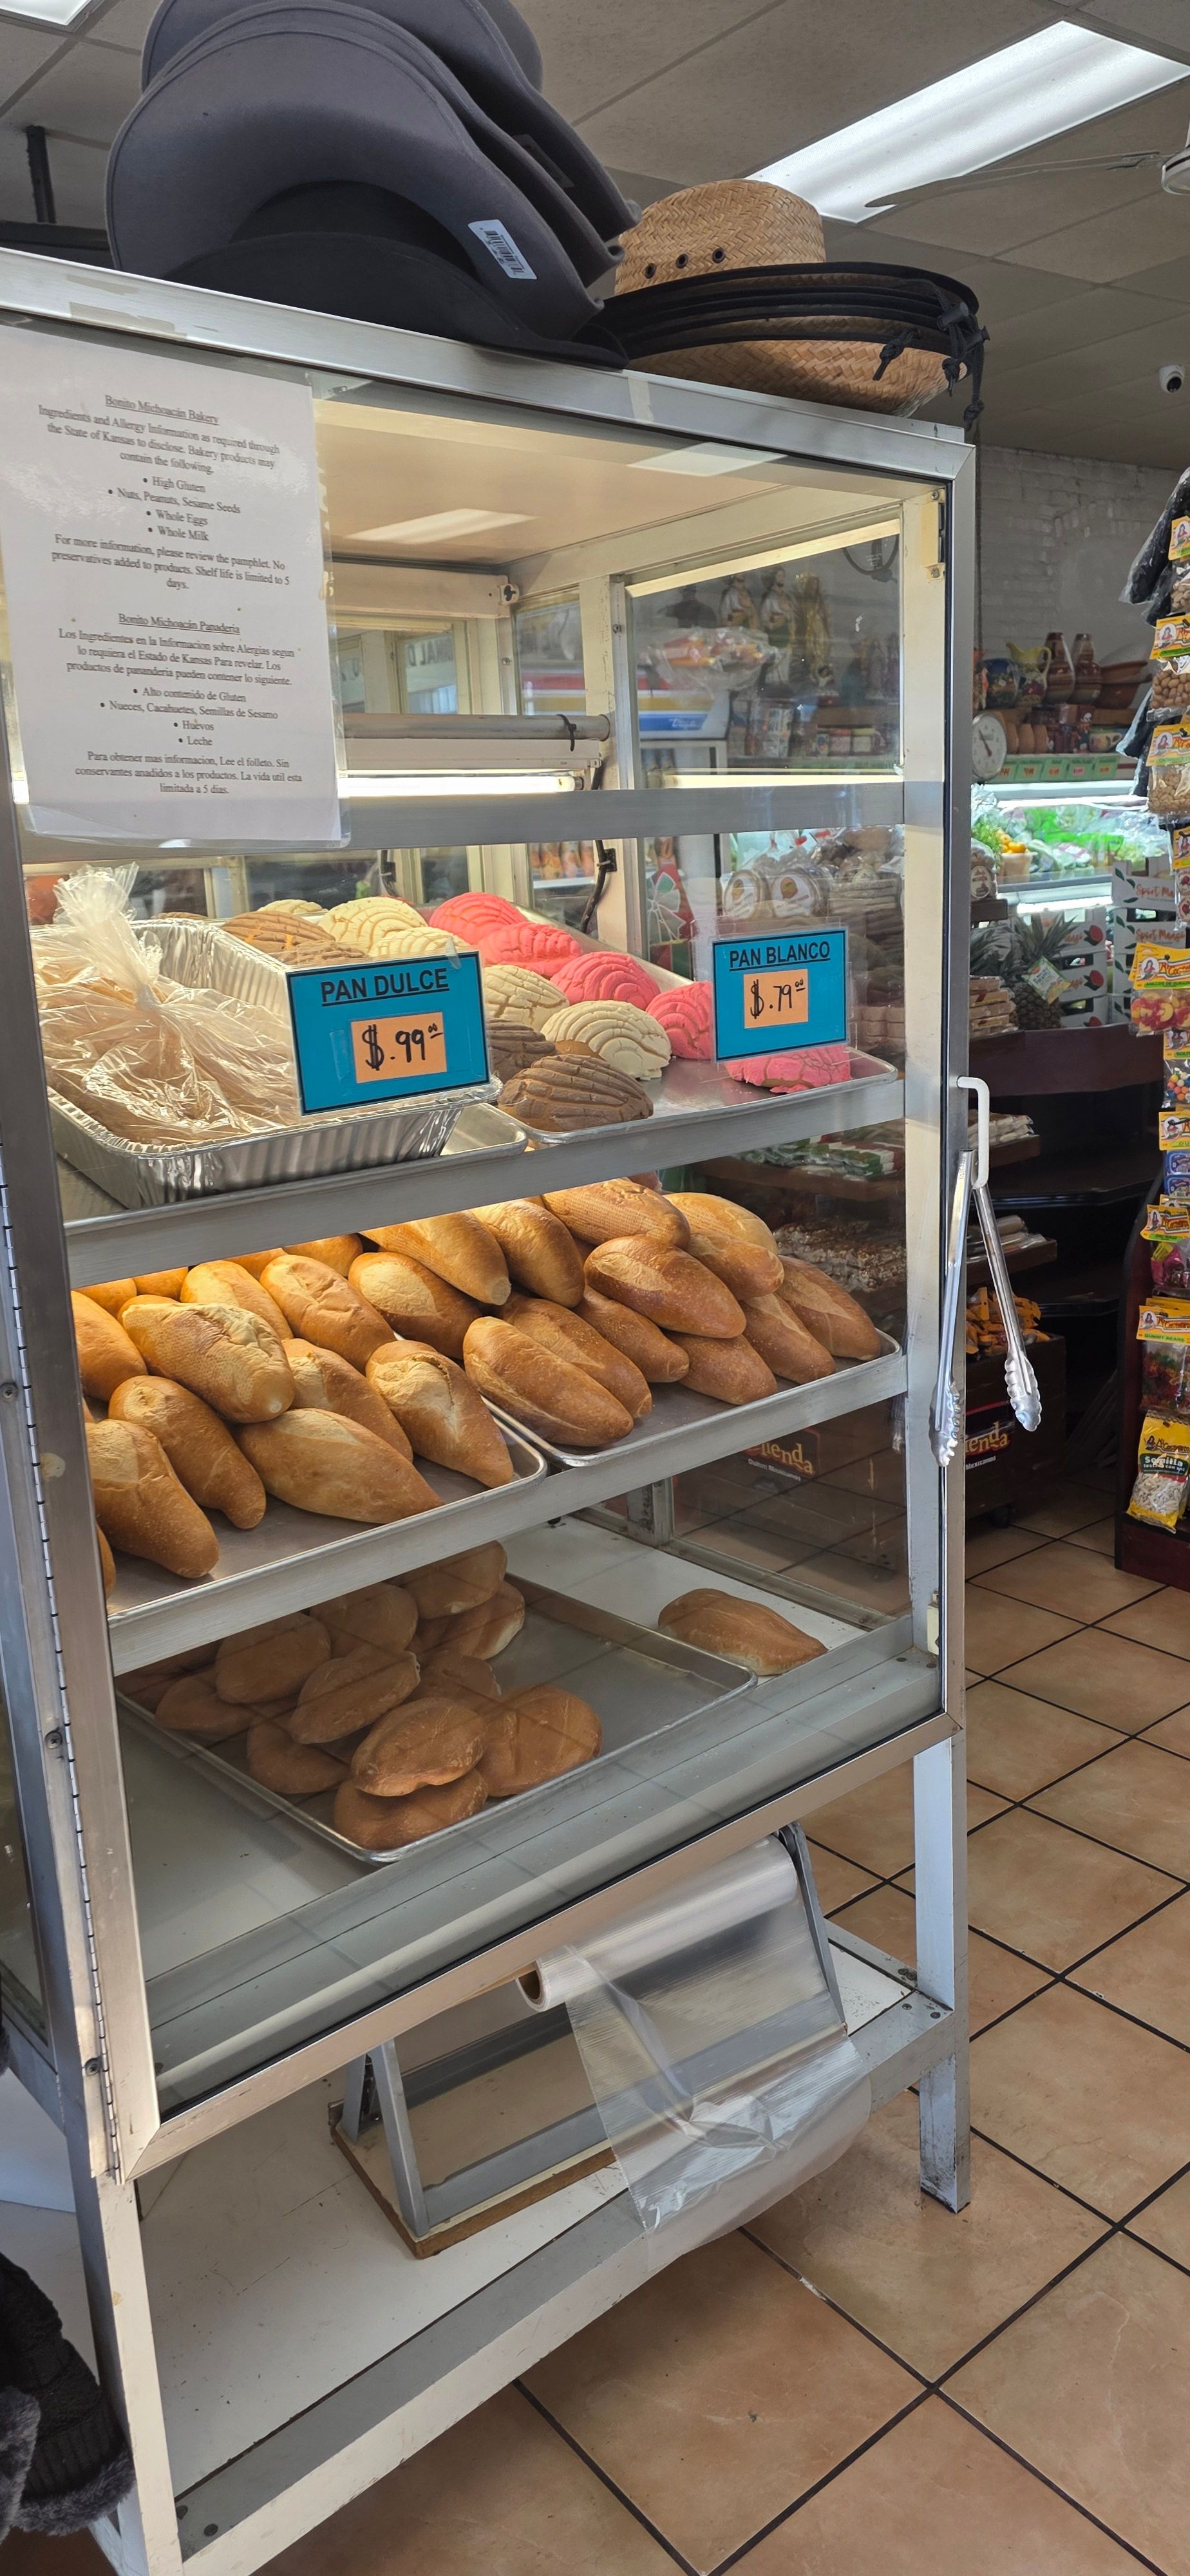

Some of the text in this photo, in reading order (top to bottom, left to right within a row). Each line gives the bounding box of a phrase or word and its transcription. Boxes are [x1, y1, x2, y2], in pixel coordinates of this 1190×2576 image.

[105, 395, 137, 409] Bonito
[188, 410, 218, 423] Bakery
[38, 404, 92, 422] Ingredients
[93, 416, 110, 426] and
[111, 418, 146, 433] Allergy
[147, 423, 200, 440] Information
[212, 437, 247, 448] required
[248, 440, 280, 455] through
[47, 423, 62, 433] the
[64, 425, 88, 437] State
[90, 430, 100, 440] of
[102, 431, 135, 445] Kansas
[137, 439, 147, 447] to
[187, 445, 219, 460] Bakery
[220, 453, 256, 464] products
[257, 459, 275, 469] may
[119, 453, 153, 464] contain
[154, 456, 169, 466] the
[152, 477, 205, 493] High Gluten
[182, 497, 214, 509] Sesame
[216, 502, 241, 513] Seeds
[156, 509, 208, 527] Whole Eggs
[157, 526, 209, 541] Whole Milk
[55, 534, 285, 570] For more information, please review the pamphlet. No
[51, 552, 112, 565] preservatives
[113, 557, 140, 568] added
[194, 566, 218, 577] Shelf
[219, 569, 234, 579] life
[235, 571, 243, 580] is
[244, 572, 273, 583] limited
[285, 576, 289, 585] 5
[118, 613, 149, 626] Bonito
[59, 629, 77, 639] Los
[79, 630, 134, 643] Ingredientes
[148, 636, 157, 645] la
[212, 643, 235, 652] sobre
[77, 645, 87, 655] lo
[127, 650, 136, 659] el
[138, 650, 168, 661] Estado
[169, 653, 180, 662] de
[182, 654, 212, 665] Kansas
[214, 657, 232, 666] Para
[266, 661, 281, 670] Los
[66, 662, 111, 672] productos
[113, 664, 124, 673] de
[175, 670, 206, 679] pueden
[207, 674, 242, 682] contener
[244, 674, 253, 683] lo
[254, 675, 292, 686] siguiente.
[142, 687, 246, 702] Alto contenido de Gluten
[109, 701, 145, 712] Nueces,
[198, 706, 234, 716] Semillas
[236, 708, 246, 717] de
[247, 709, 278, 719] Sesamo
[182, 719, 214, 730] Huevos
[187, 736, 212, 745] Leche
[88, 751, 108, 761] Para
[109, 752, 143, 762] obtener
[219, 757, 235, 765] Lee
[236, 757, 245, 766] el
[246, 758, 274, 767] folleto.
[276, 759, 290, 768] Sin
[182, 770, 194, 779] los
[196, 770, 238, 781] productos.
[240, 772, 251, 780] La
[253, 772, 270, 781] vida
[160, 783, 194, 793] limitada
[730, 941, 830, 968] PAN BLANCO
[320, 968, 449, 1003] PAN DULCE
[966, 1420, 1008, 1453] ienda
